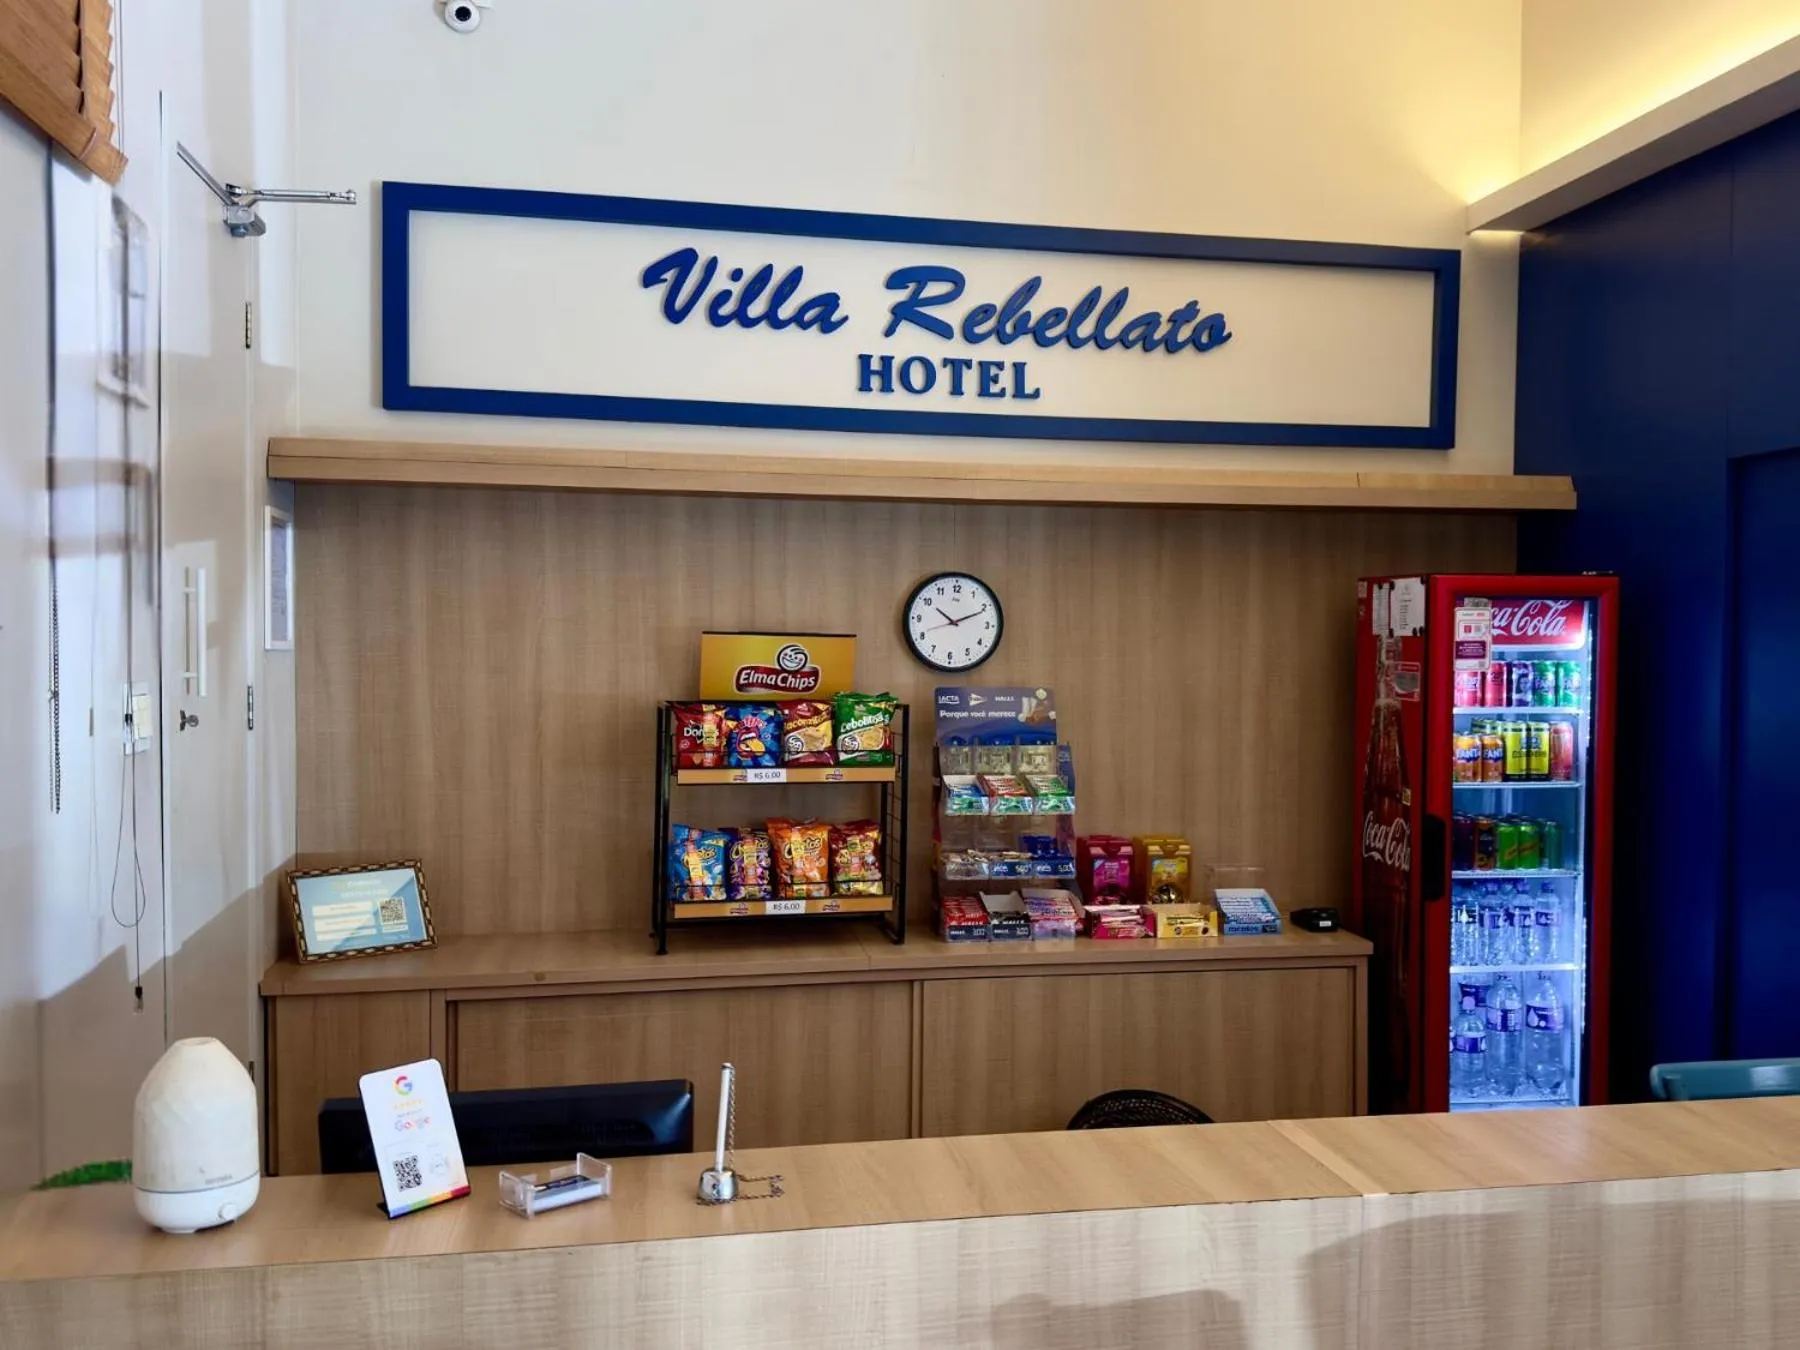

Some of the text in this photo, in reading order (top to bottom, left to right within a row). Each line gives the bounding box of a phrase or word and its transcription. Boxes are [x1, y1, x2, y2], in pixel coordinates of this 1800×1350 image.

[641, 247, 1232, 354] Villa Rebellato
[857, 353, 1041, 400] HOTEL
[936, 588, 944, 596] 11
[952, 585, 962, 594] 12
[924, 598, 932, 606] 10
[1491, 599, 1573, 637] ca-Cola
